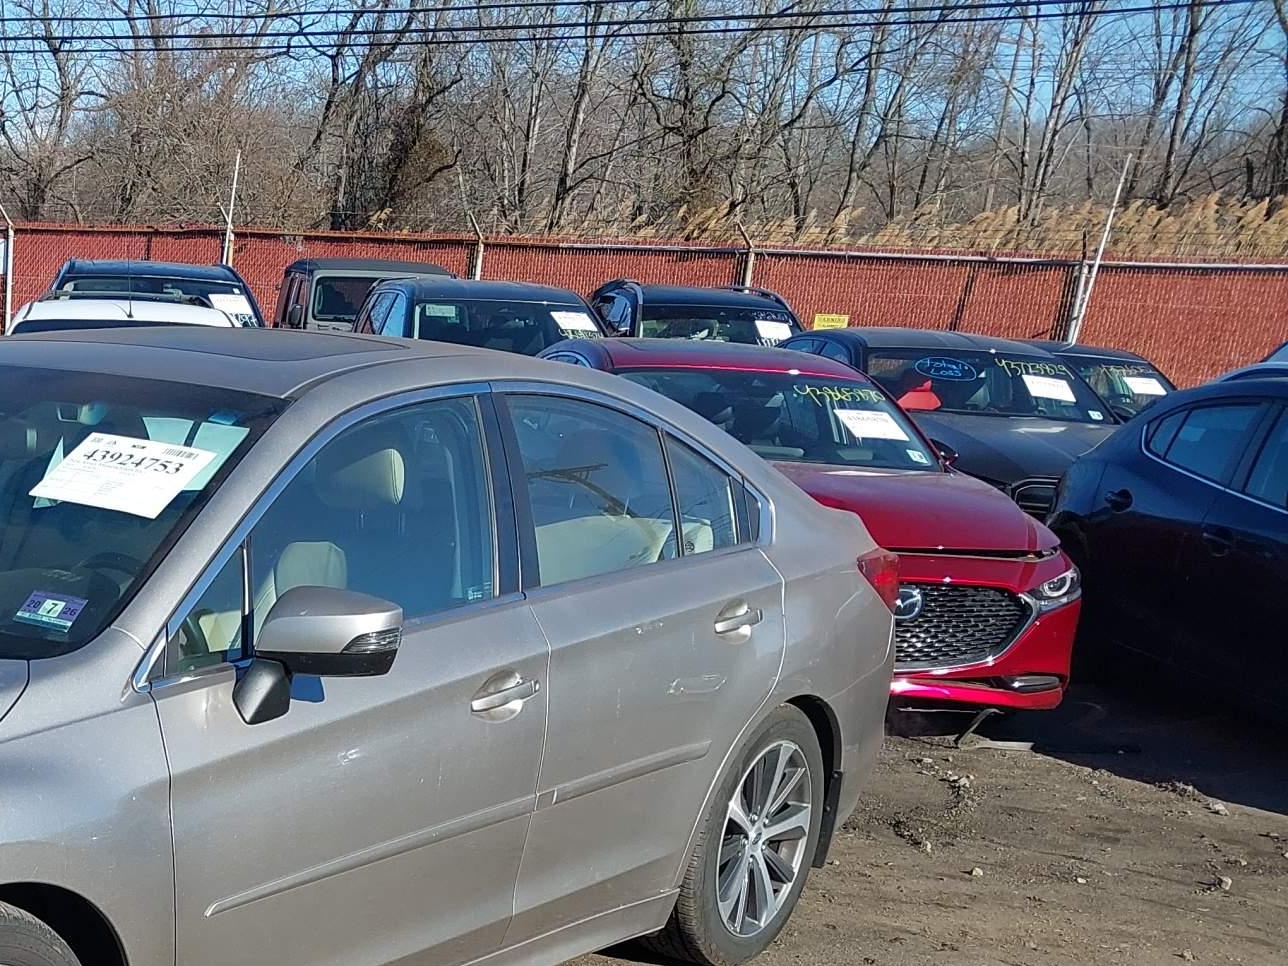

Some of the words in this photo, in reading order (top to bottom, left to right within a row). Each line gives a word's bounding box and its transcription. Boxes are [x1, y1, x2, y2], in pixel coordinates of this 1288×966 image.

[83, 448, 185, 476] 43924753
[26, 599, 41, 609] 20
[46, 602, 59, 614] 7
[62, 606, 78, 616] 26
